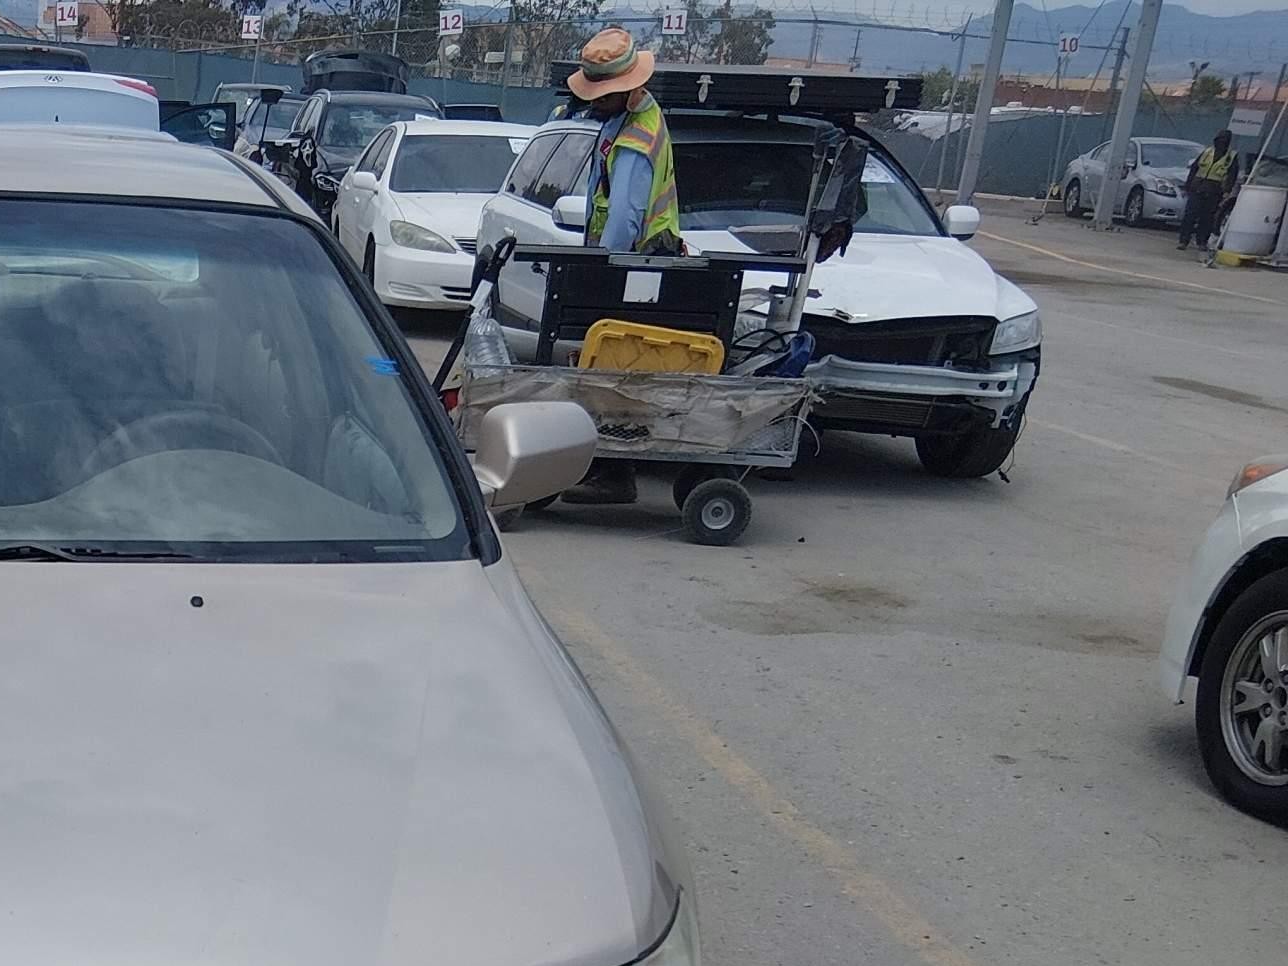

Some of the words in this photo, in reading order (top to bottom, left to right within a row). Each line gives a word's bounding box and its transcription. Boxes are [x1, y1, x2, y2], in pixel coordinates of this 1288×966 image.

[58, 6, 76, 21] 14
[243, 20, 261, 34] 13
[441, 14, 462, 31] 12
[664, 14, 684, 30] 11
[1060, 37, 1079, 53] 10
